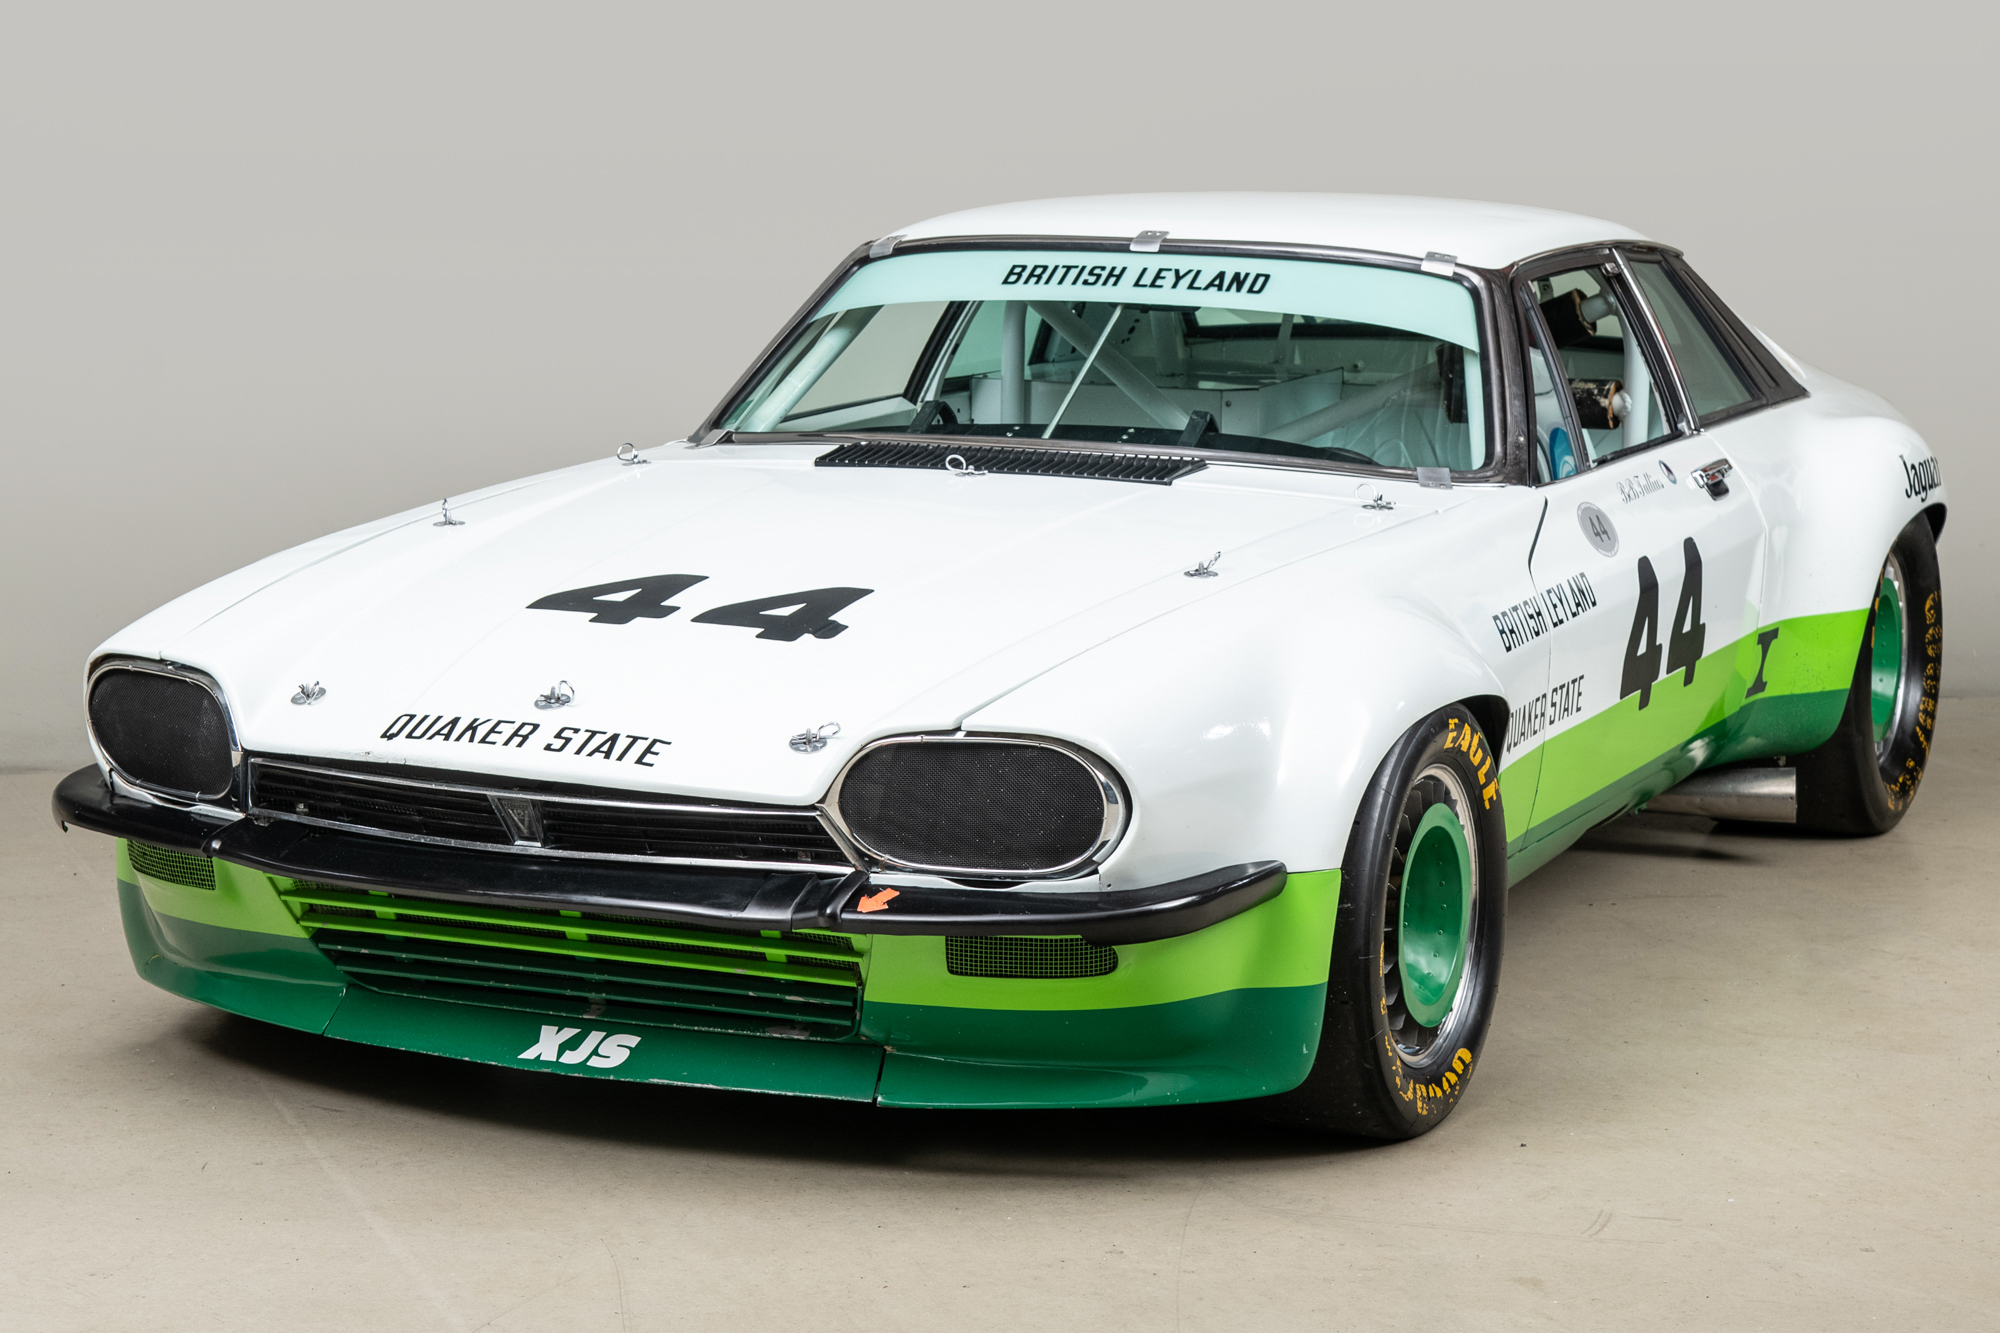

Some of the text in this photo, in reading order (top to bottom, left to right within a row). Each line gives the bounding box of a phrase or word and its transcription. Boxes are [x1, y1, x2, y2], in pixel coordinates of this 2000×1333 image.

[1001, 264, 1271, 295] BRITISH LEYLAND
[1588, 514, 1611, 543] 44
[526, 574, 875, 642] 44
[1492, 571, 1598, 653] BRITISH LEYLAND
[1619, 536, 1706, 711] 44
[380, 713, 672, 768] QUAKER STATE
[1506, 674, 1584, 755] QUAKER STATE
[1443, 718, 1501, 810] EAGLE
[516, 1024, 642, 1069] XJS
